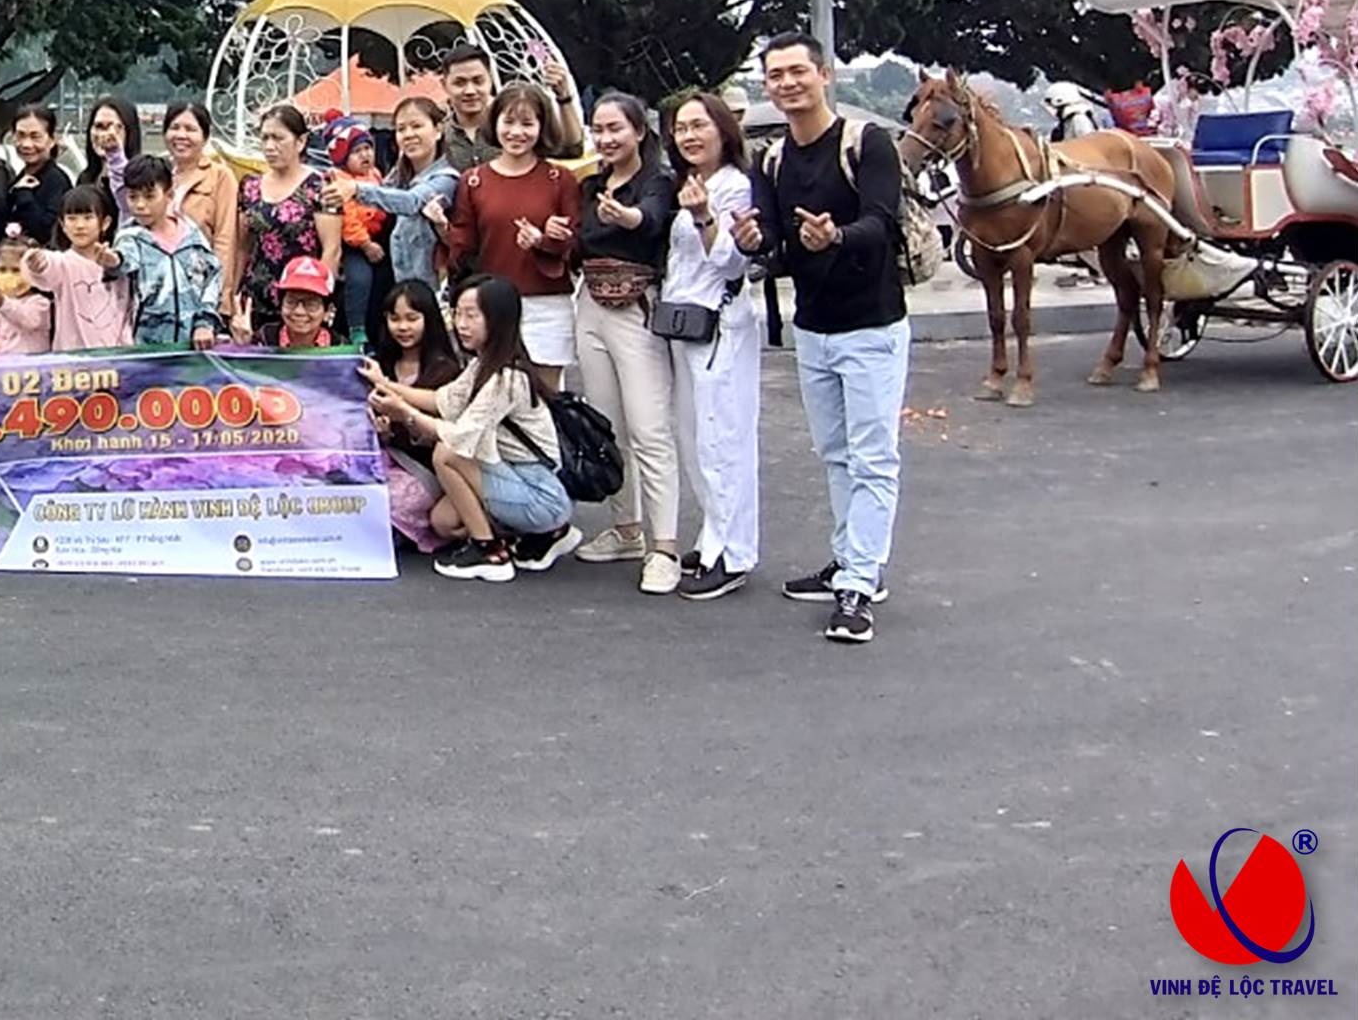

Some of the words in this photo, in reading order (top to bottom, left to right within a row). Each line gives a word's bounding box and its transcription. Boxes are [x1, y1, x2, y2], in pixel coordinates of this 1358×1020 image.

[2, 370, 41, 396] 02
[150, 432, 172, 449] 15
[32, 499, 81, 522] CÔNG
[83, 501, 108, 521] TY
[139, 496, 188, 520] HÀNH
[191, 499, 234, 519] VINH
[306, 496, 368, 516] GROUP
